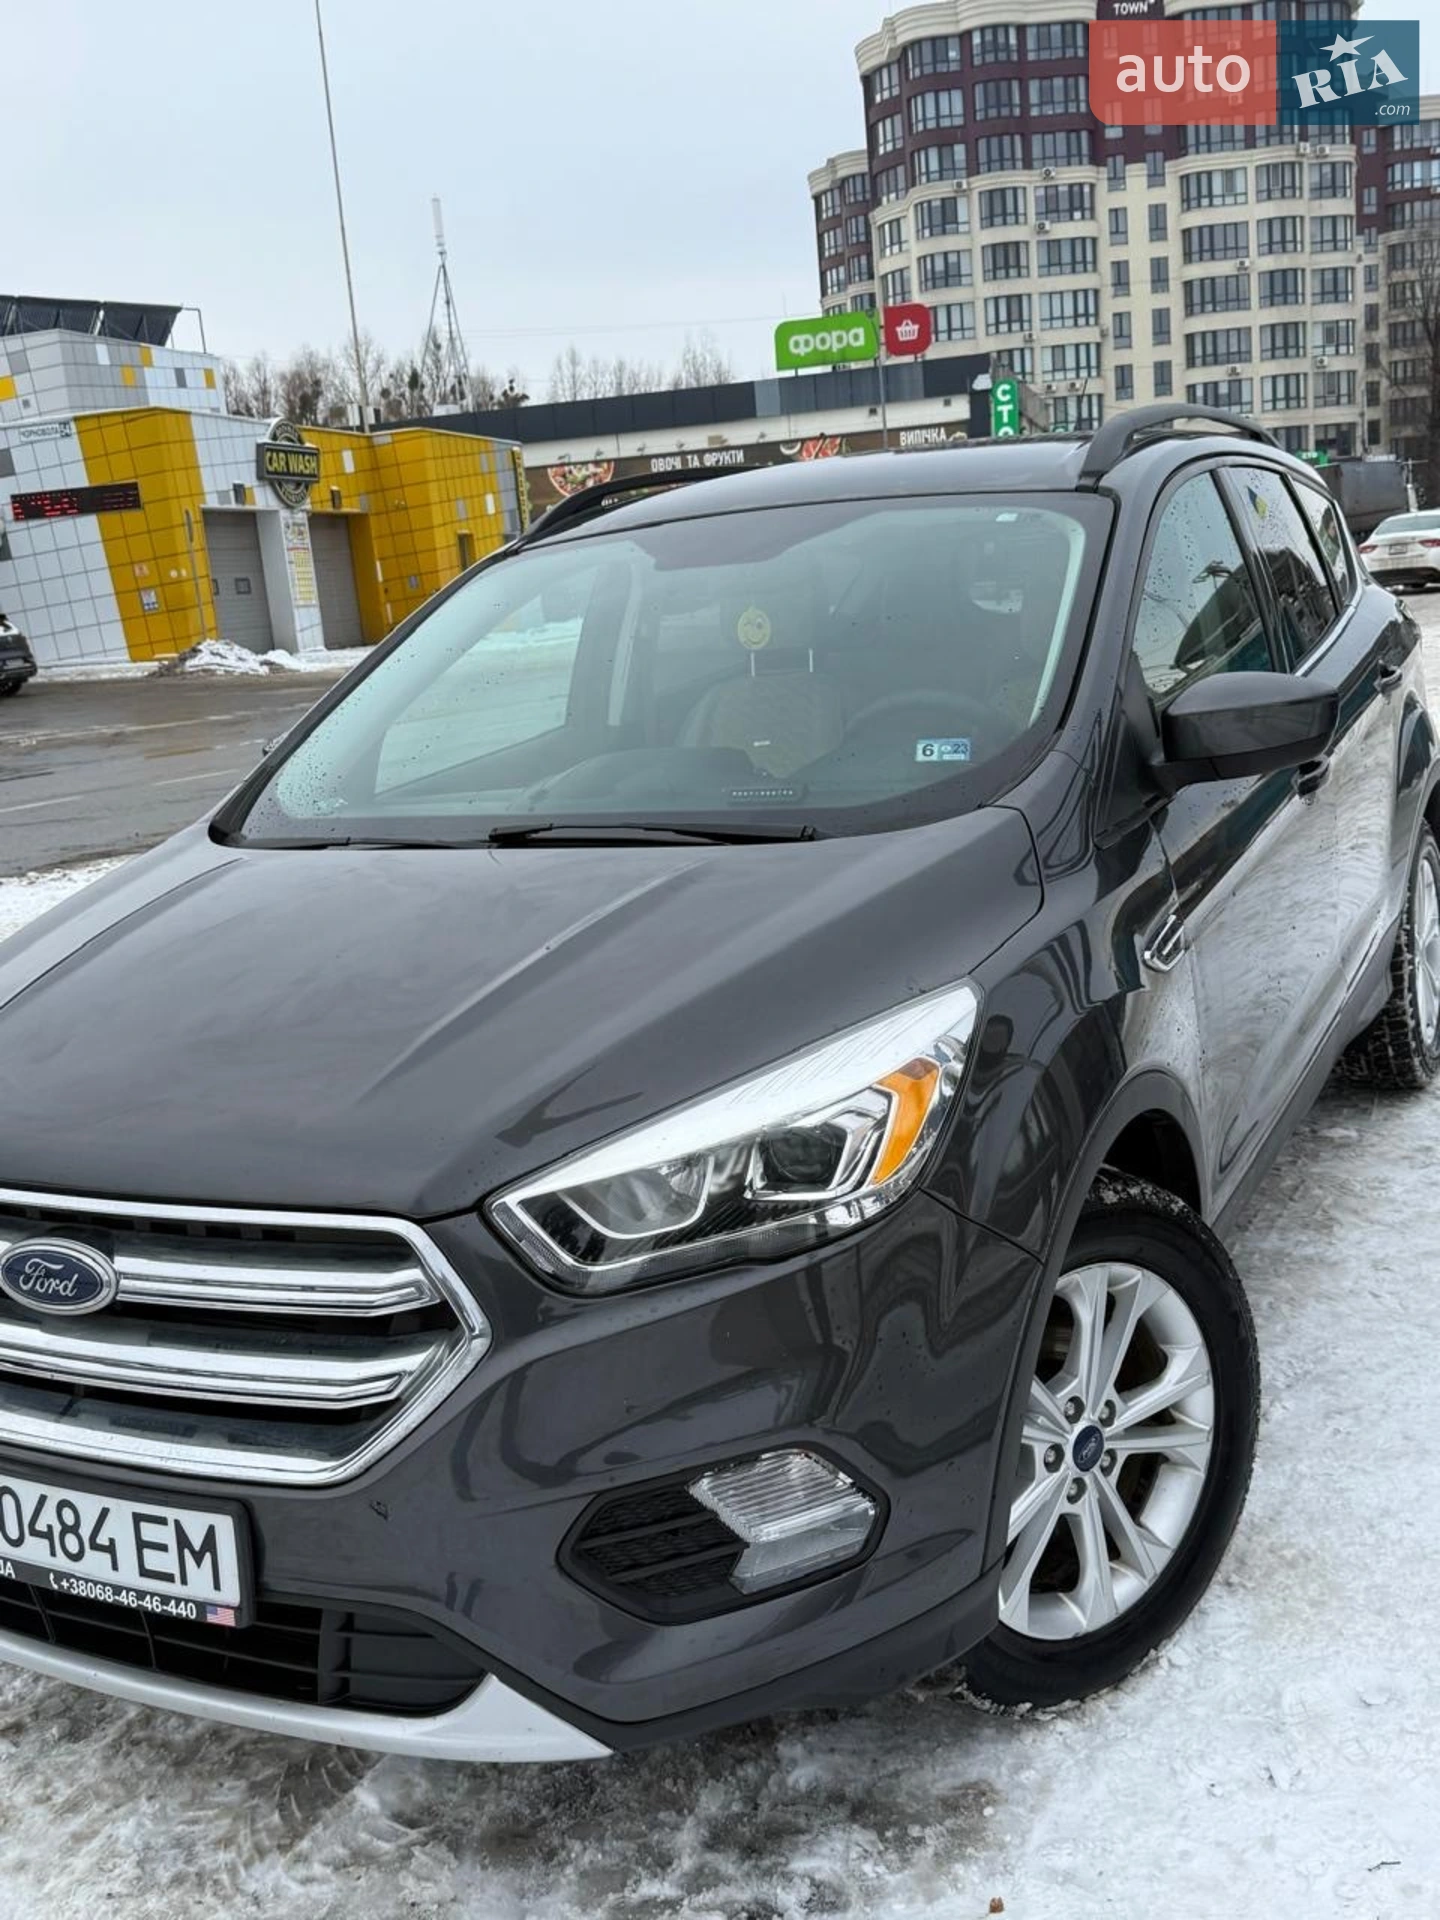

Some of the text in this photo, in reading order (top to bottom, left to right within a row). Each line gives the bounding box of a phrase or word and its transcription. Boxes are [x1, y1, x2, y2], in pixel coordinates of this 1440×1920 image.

[1113, 1, 1148, 15] TOWN
[788, 327, 865, 356] фора
[900, 427, 947, 446] ВИПІЧКА
[266, 451, 317, 475] CAR WASH
[651, 449, 745, 472] ОВОЧІ ТА ФРУКТИ
[922, 743, 935, 757] 6
[19, 1258, 79, 1297] Ford
[132, 1511, 221, 1592] EM
[60, 1578, 196, 1619] +38068-46-46-440
